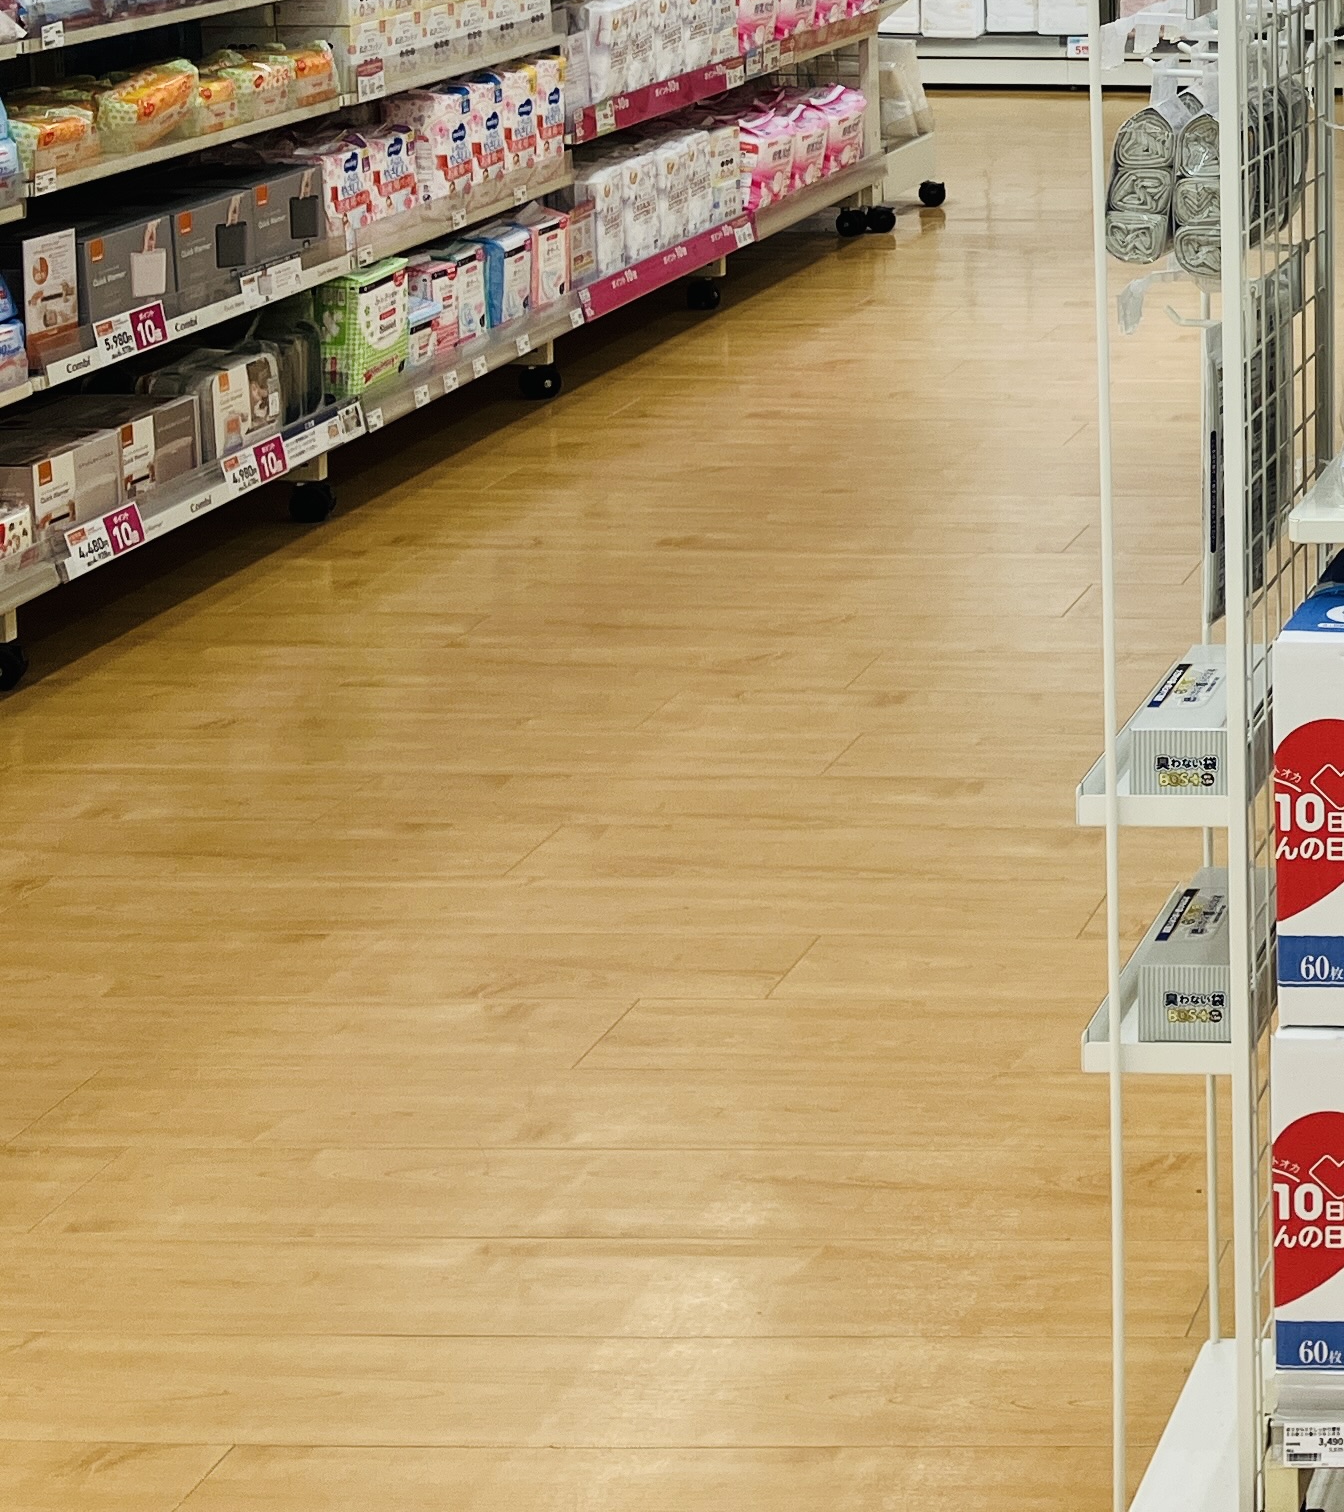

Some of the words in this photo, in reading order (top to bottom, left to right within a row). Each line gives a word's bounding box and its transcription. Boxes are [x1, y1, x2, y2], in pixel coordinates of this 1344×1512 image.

[174, 316, 198, 332] Combi
[66, 356, 91, 373] Combi
[1155, 756, 1218, 771] 臭わない袋
[1164, 993, 1225, 1007] 臭わない袋
